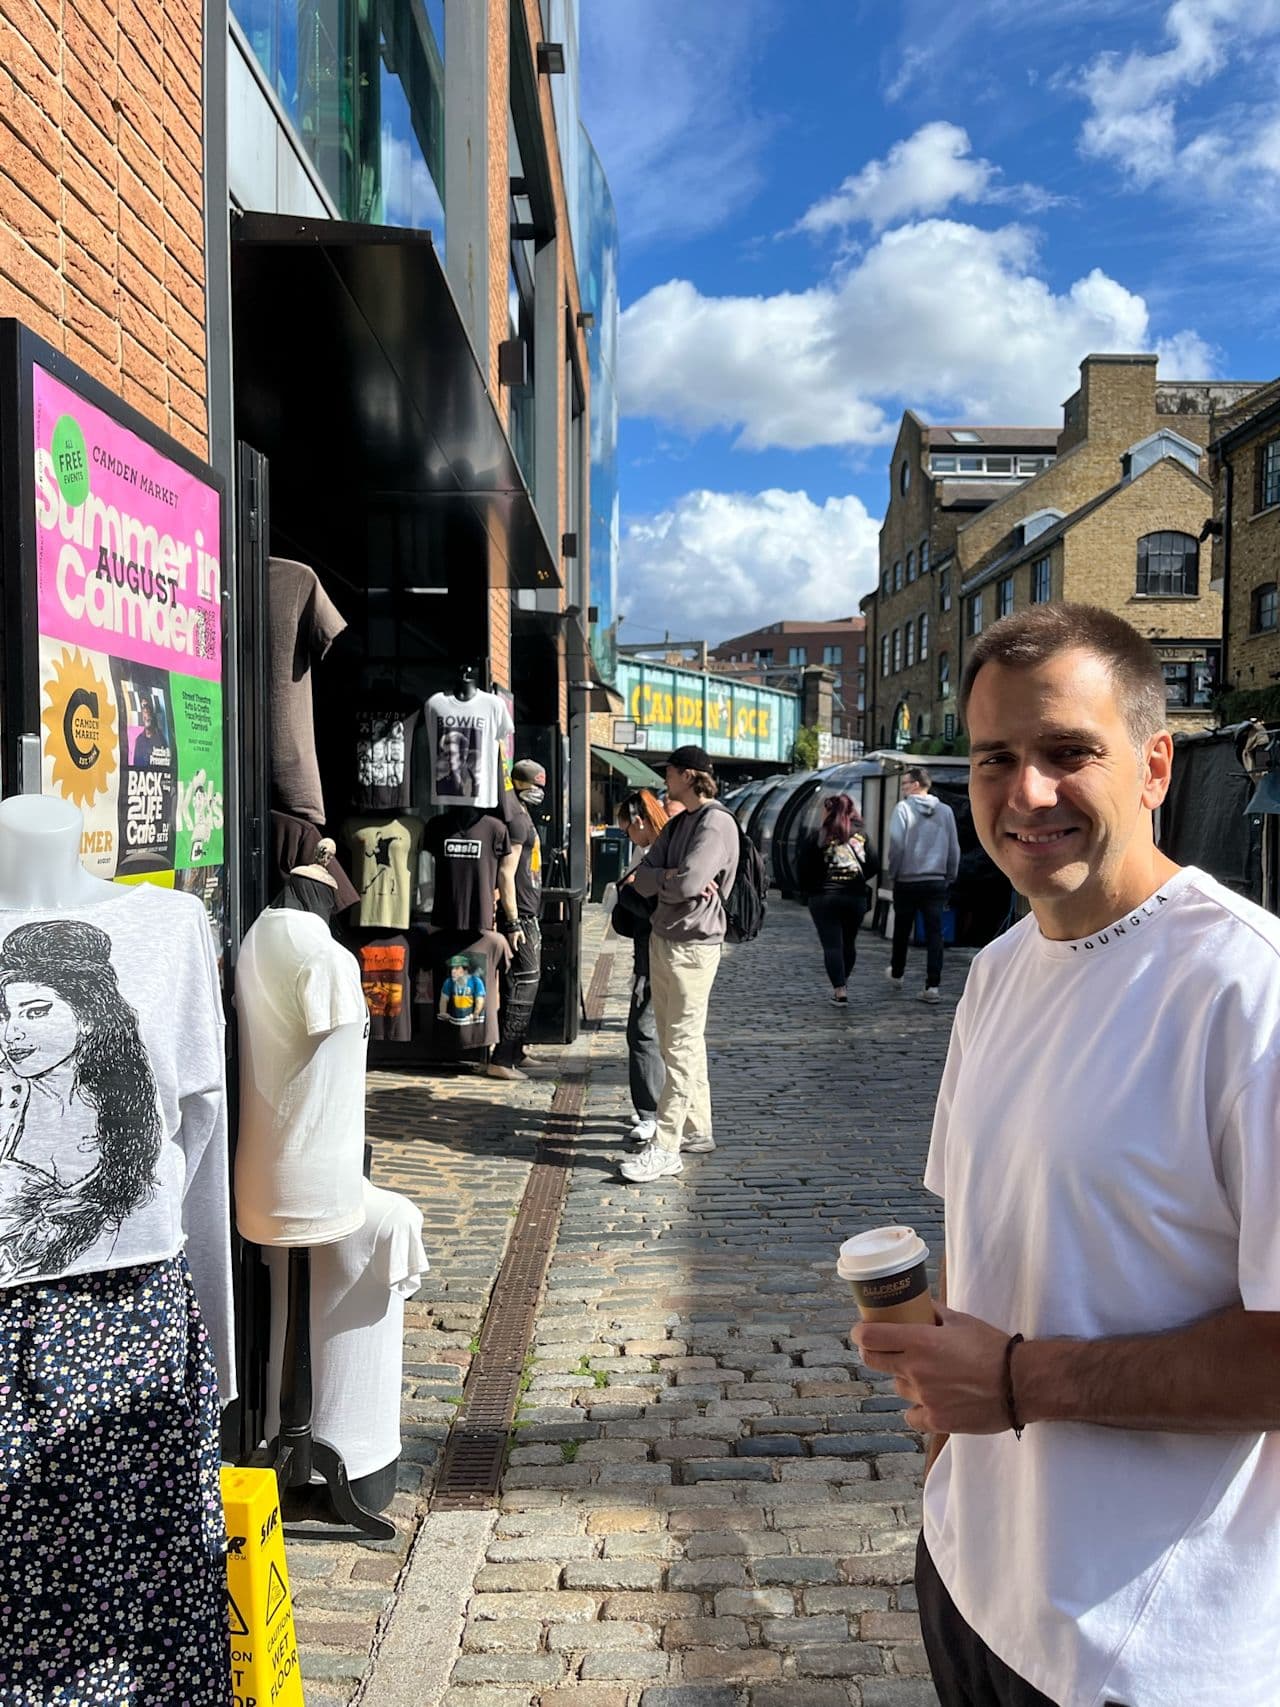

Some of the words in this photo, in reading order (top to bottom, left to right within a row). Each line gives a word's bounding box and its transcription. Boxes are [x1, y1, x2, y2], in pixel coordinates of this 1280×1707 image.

[58, 450, 84, 473] FREE
[64, 472, 84, 484] EVENTS
[92, 446, 138, 485] CAMDEN
[140, 474, 179, 509] MARKET
[35, 447, 192, 591] Summer
[195, 528, 221, 605] in
[96, 545, 178, 608] AUGUST
[74, 718, 99, 730] CAMDEN
[437, 714, 486, 729] BOWIE
[631, 684, 720, 730] CAMDEN
[726, 698, 769, 739] LOCK
[75, 730, 100, 740] MARKET
[128, 770, 163, 796] BACK
[156, 832, 168, 842] SETS
[446, 842, 479, 854] oasis
[266, 1609, 292, 1654] CAUTION
[272, 1631, 290, 1671] WET
[270, 1649, 297, 1705] FLOOR
